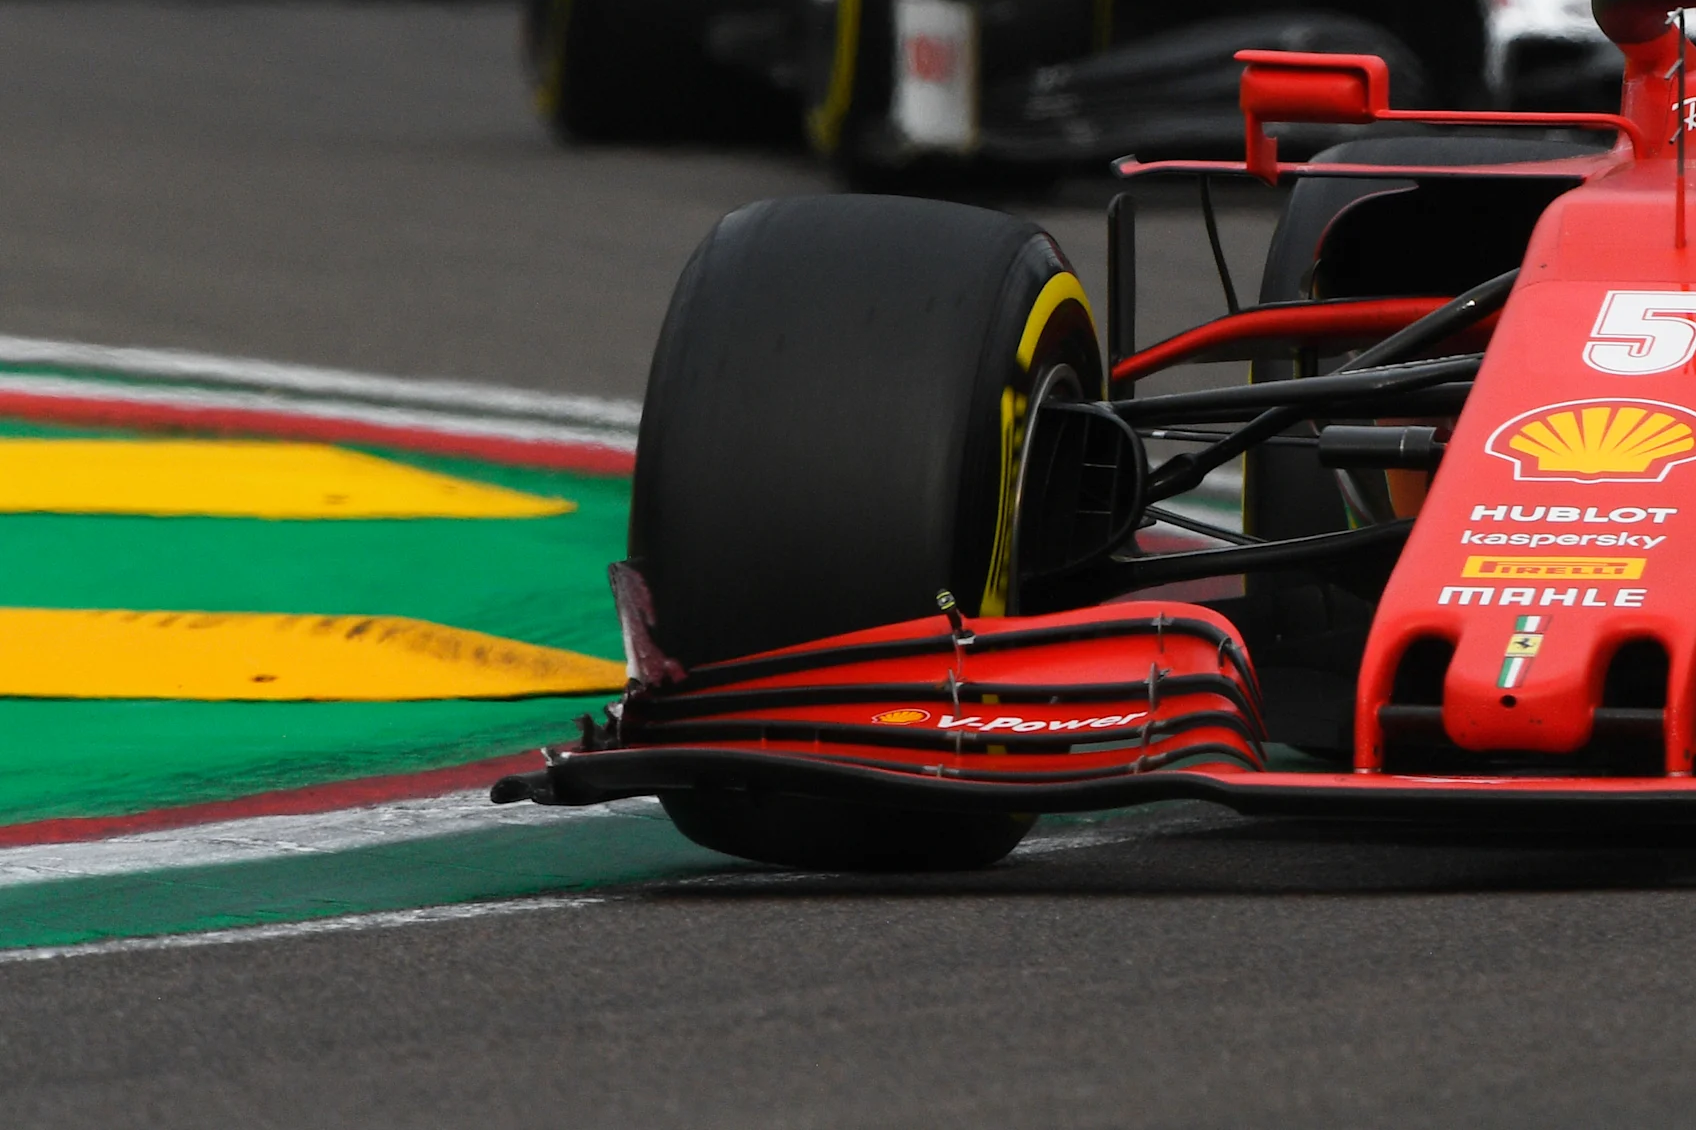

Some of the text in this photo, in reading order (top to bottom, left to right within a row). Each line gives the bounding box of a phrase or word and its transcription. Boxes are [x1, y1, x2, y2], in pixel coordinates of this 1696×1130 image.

[1470, 505, 1679, 523] HUBLOT
[1461, 530, 1667, 549] kaspersky
[1478, 560, 1629, 576] PIRELLI
[1438, 586, 1648, 607] MAHLE
[935, 711, 1148, 733] V-Power
